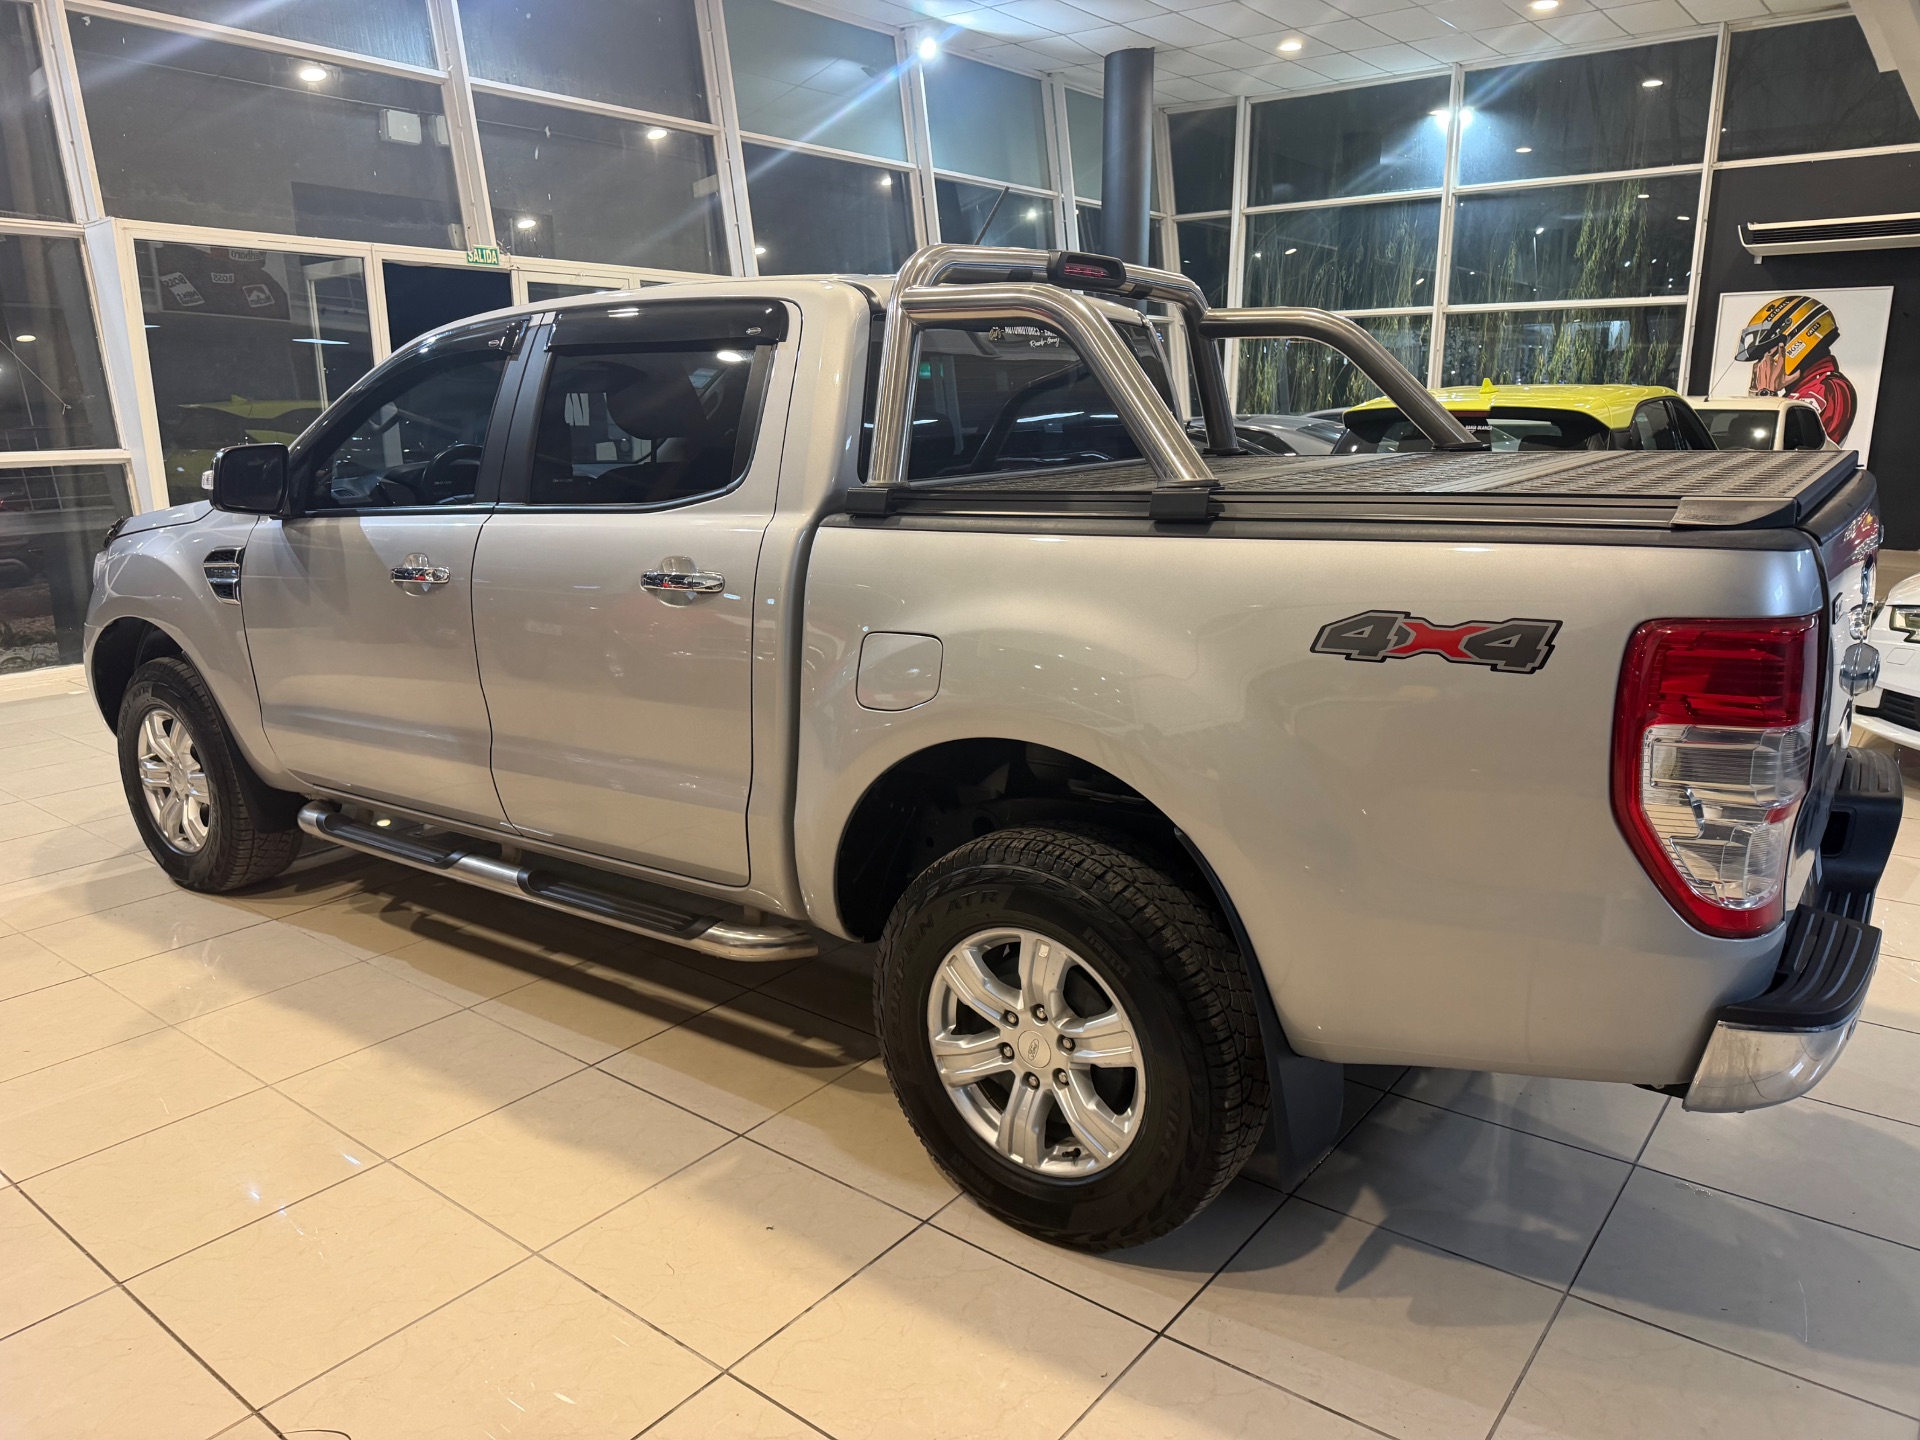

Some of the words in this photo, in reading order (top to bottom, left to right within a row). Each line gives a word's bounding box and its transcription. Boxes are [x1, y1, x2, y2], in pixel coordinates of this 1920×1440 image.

[467, 248, 498, 264] SALIDA
[1786, 340, 1803, 356] BOSS
[946, 890, 1000, 914] ATR
